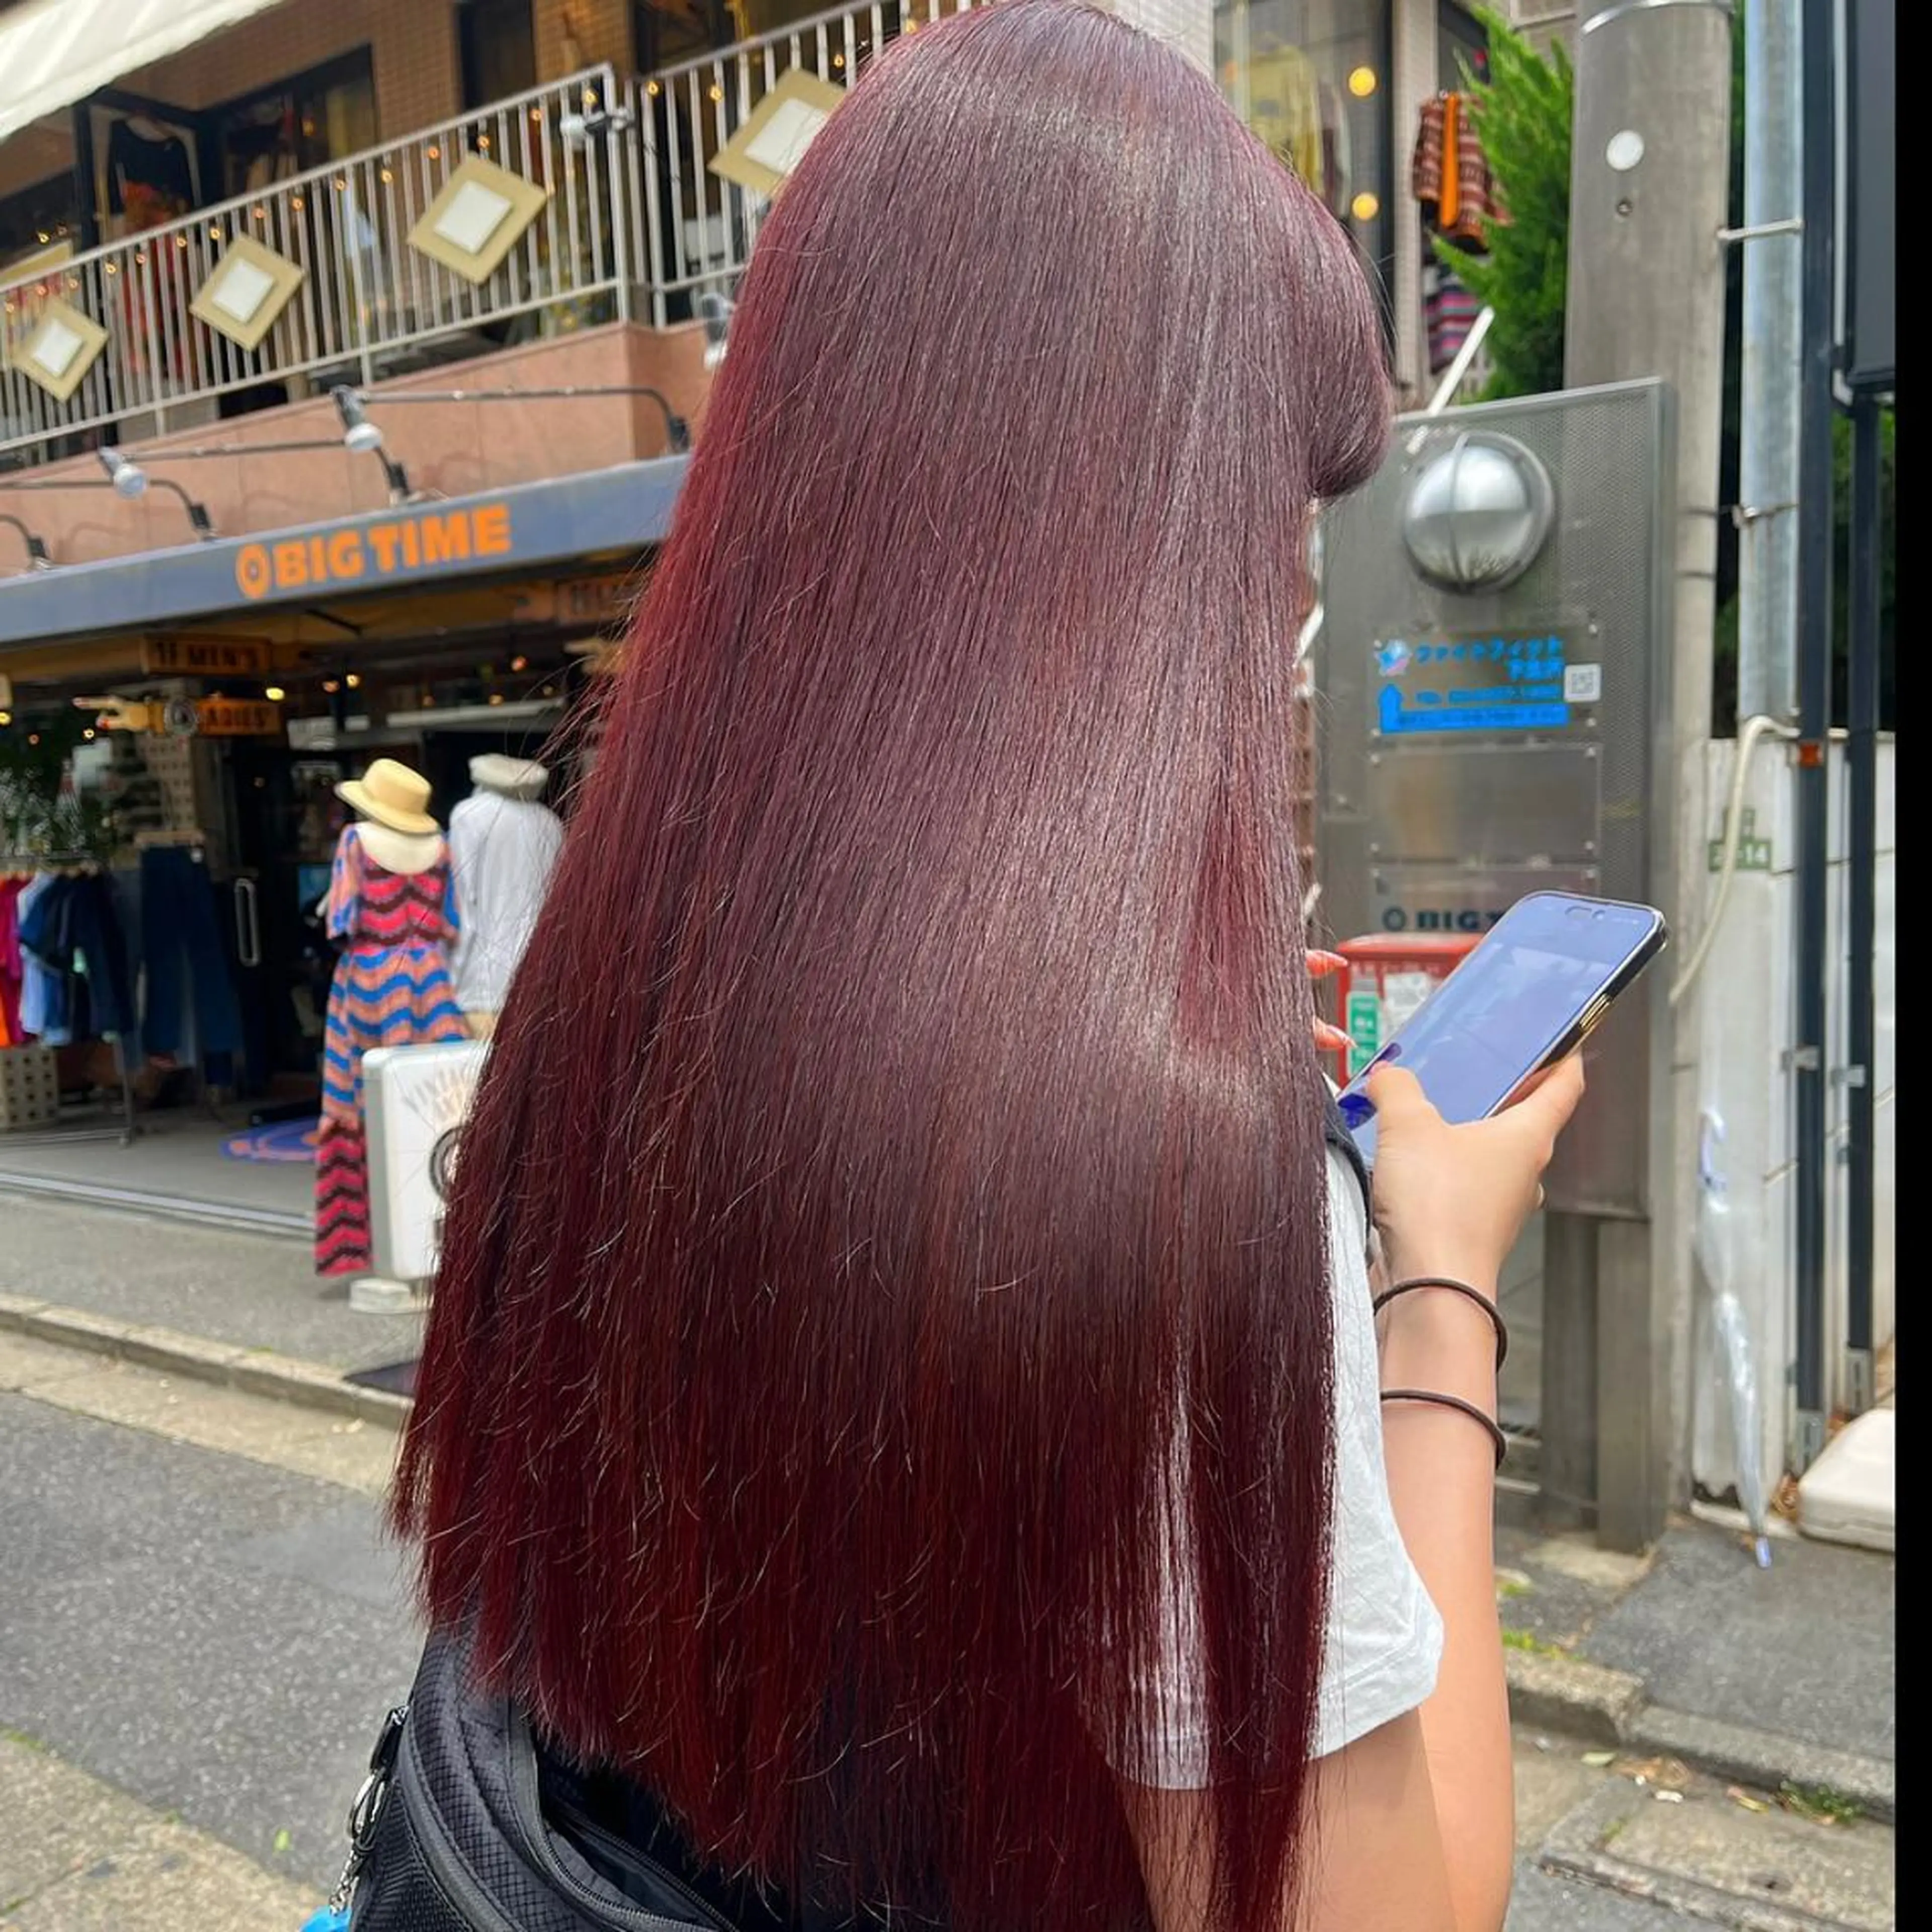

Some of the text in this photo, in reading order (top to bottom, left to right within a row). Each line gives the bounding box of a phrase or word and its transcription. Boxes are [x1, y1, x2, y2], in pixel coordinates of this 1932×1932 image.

[273, 505, 511, 589] BIG TIME
[1417, 911, 1479, 930] BIG
